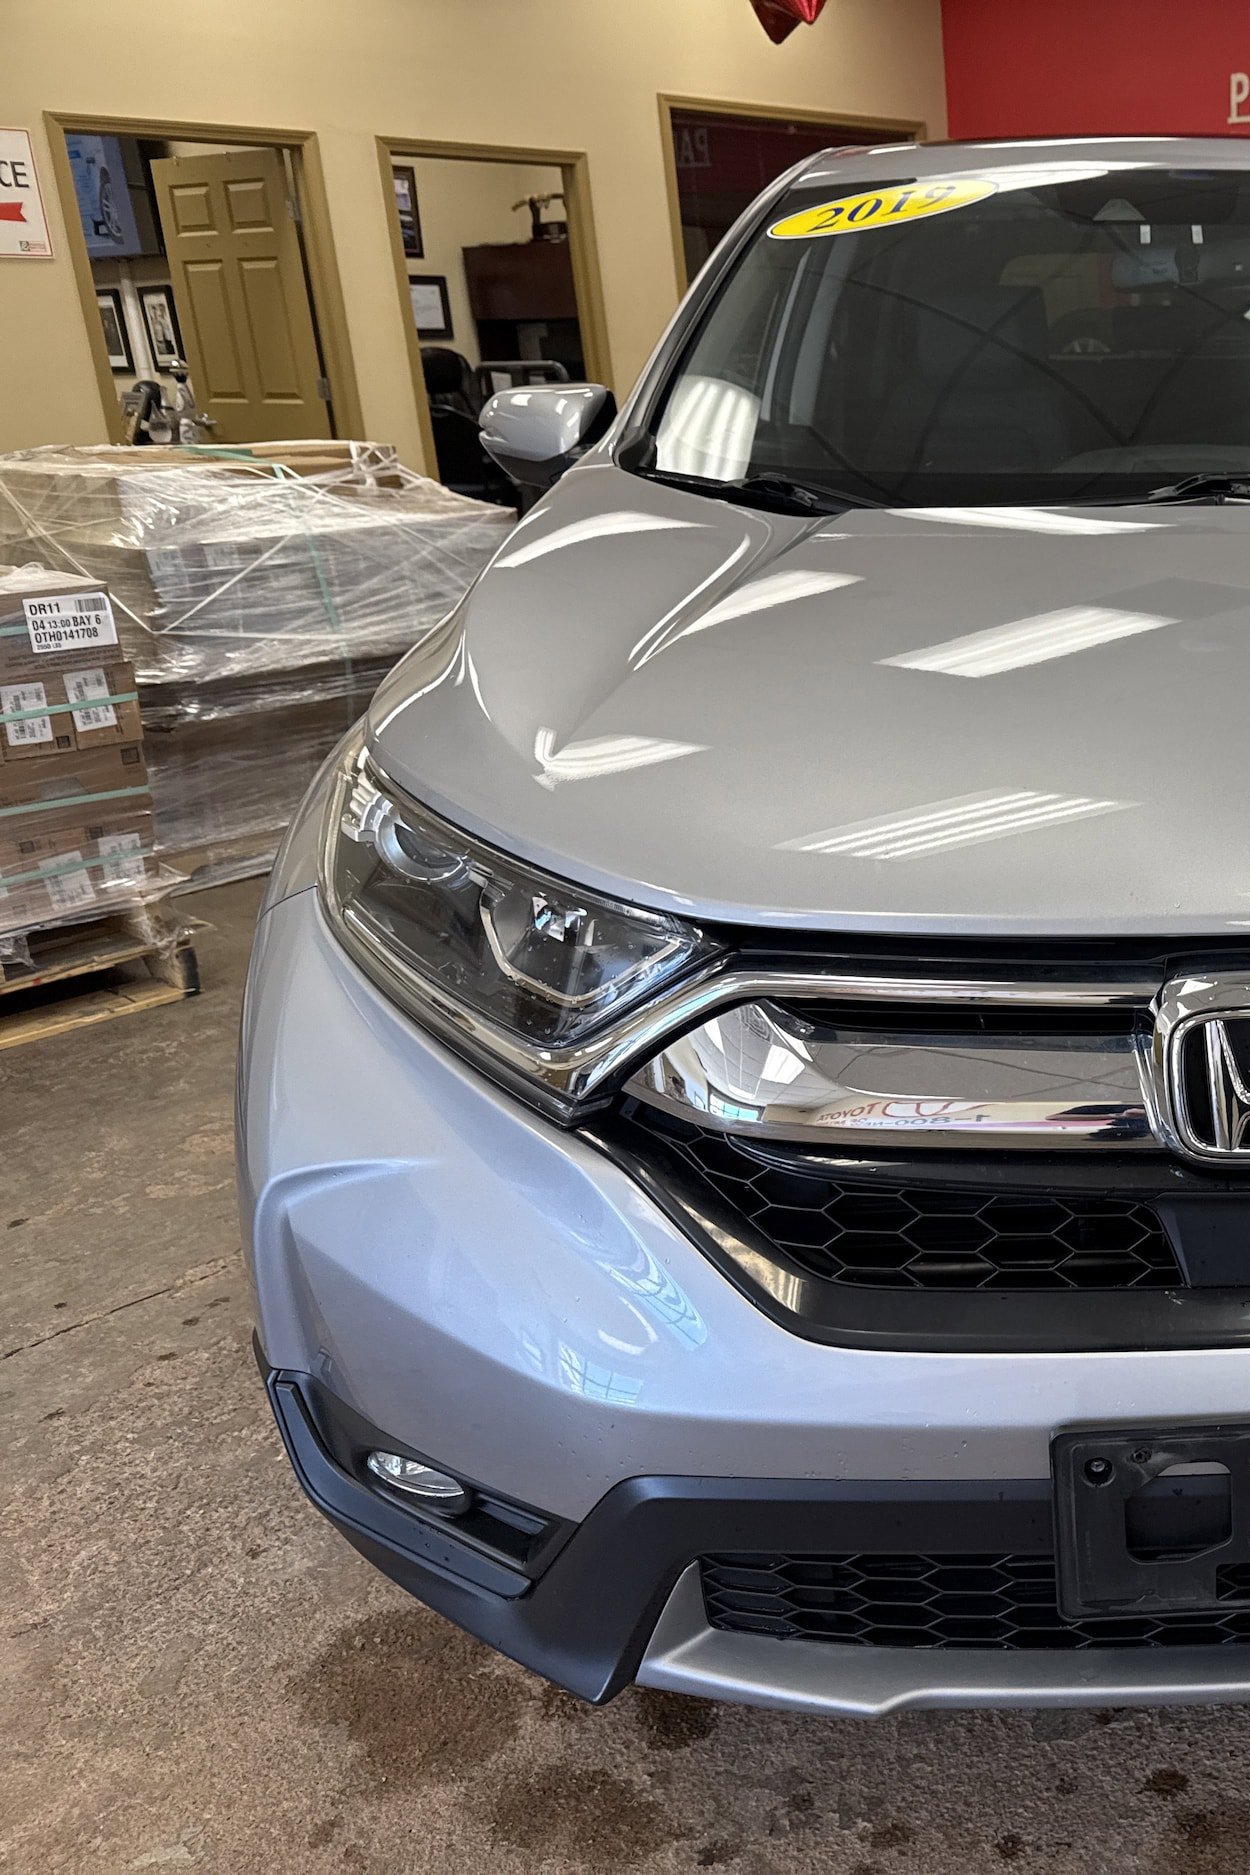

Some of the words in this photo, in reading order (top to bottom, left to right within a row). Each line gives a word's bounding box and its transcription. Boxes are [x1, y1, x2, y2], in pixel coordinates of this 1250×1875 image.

[806, 185, 956, 233] 2019
[28, 602, 61, 616] DR11
[48, 618, 71, 629] 13:00
[72, 614, 91, 627] BAY
[95, 614, 102, 625] 6
